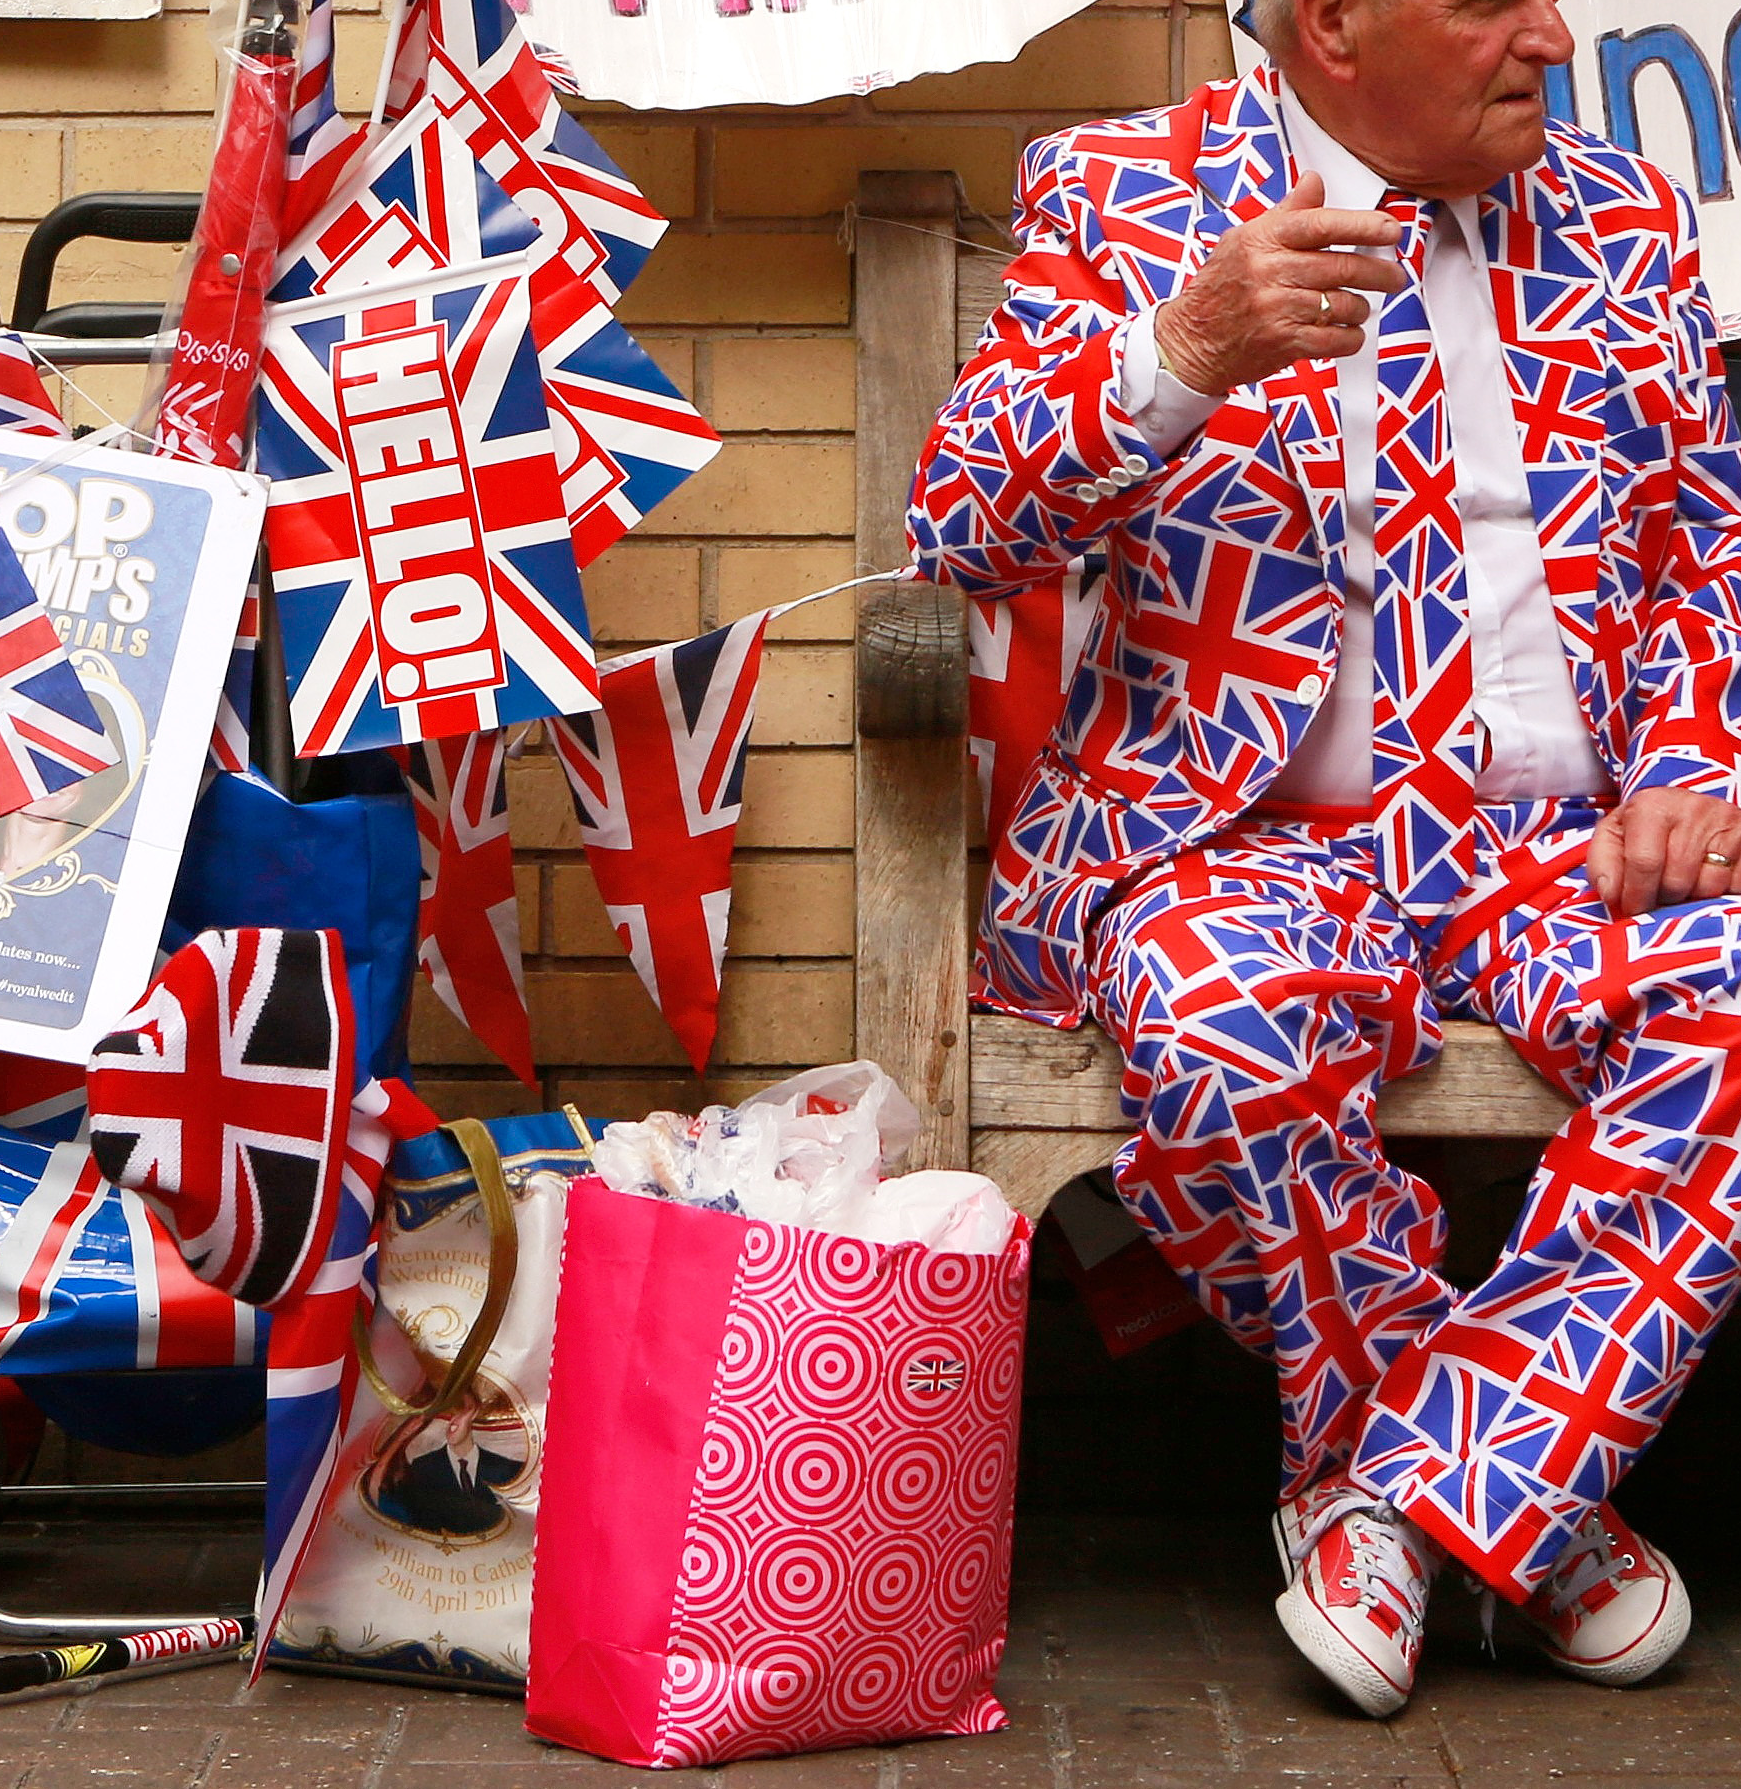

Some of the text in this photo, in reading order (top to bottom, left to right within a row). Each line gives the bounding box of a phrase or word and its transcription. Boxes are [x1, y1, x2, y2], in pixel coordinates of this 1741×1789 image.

[340, 330, 497, 699] HELLO!
[54, 615, 150, 658] CIALS
[388, 1265, 488, 1299] Wedding
[373, 1534, 444, 1583] William
[449, 1567, 467, 1586] to
[472, 1551, 534, 1585] Cather
[376, 1566, 518, 1615] 29th April 2011
